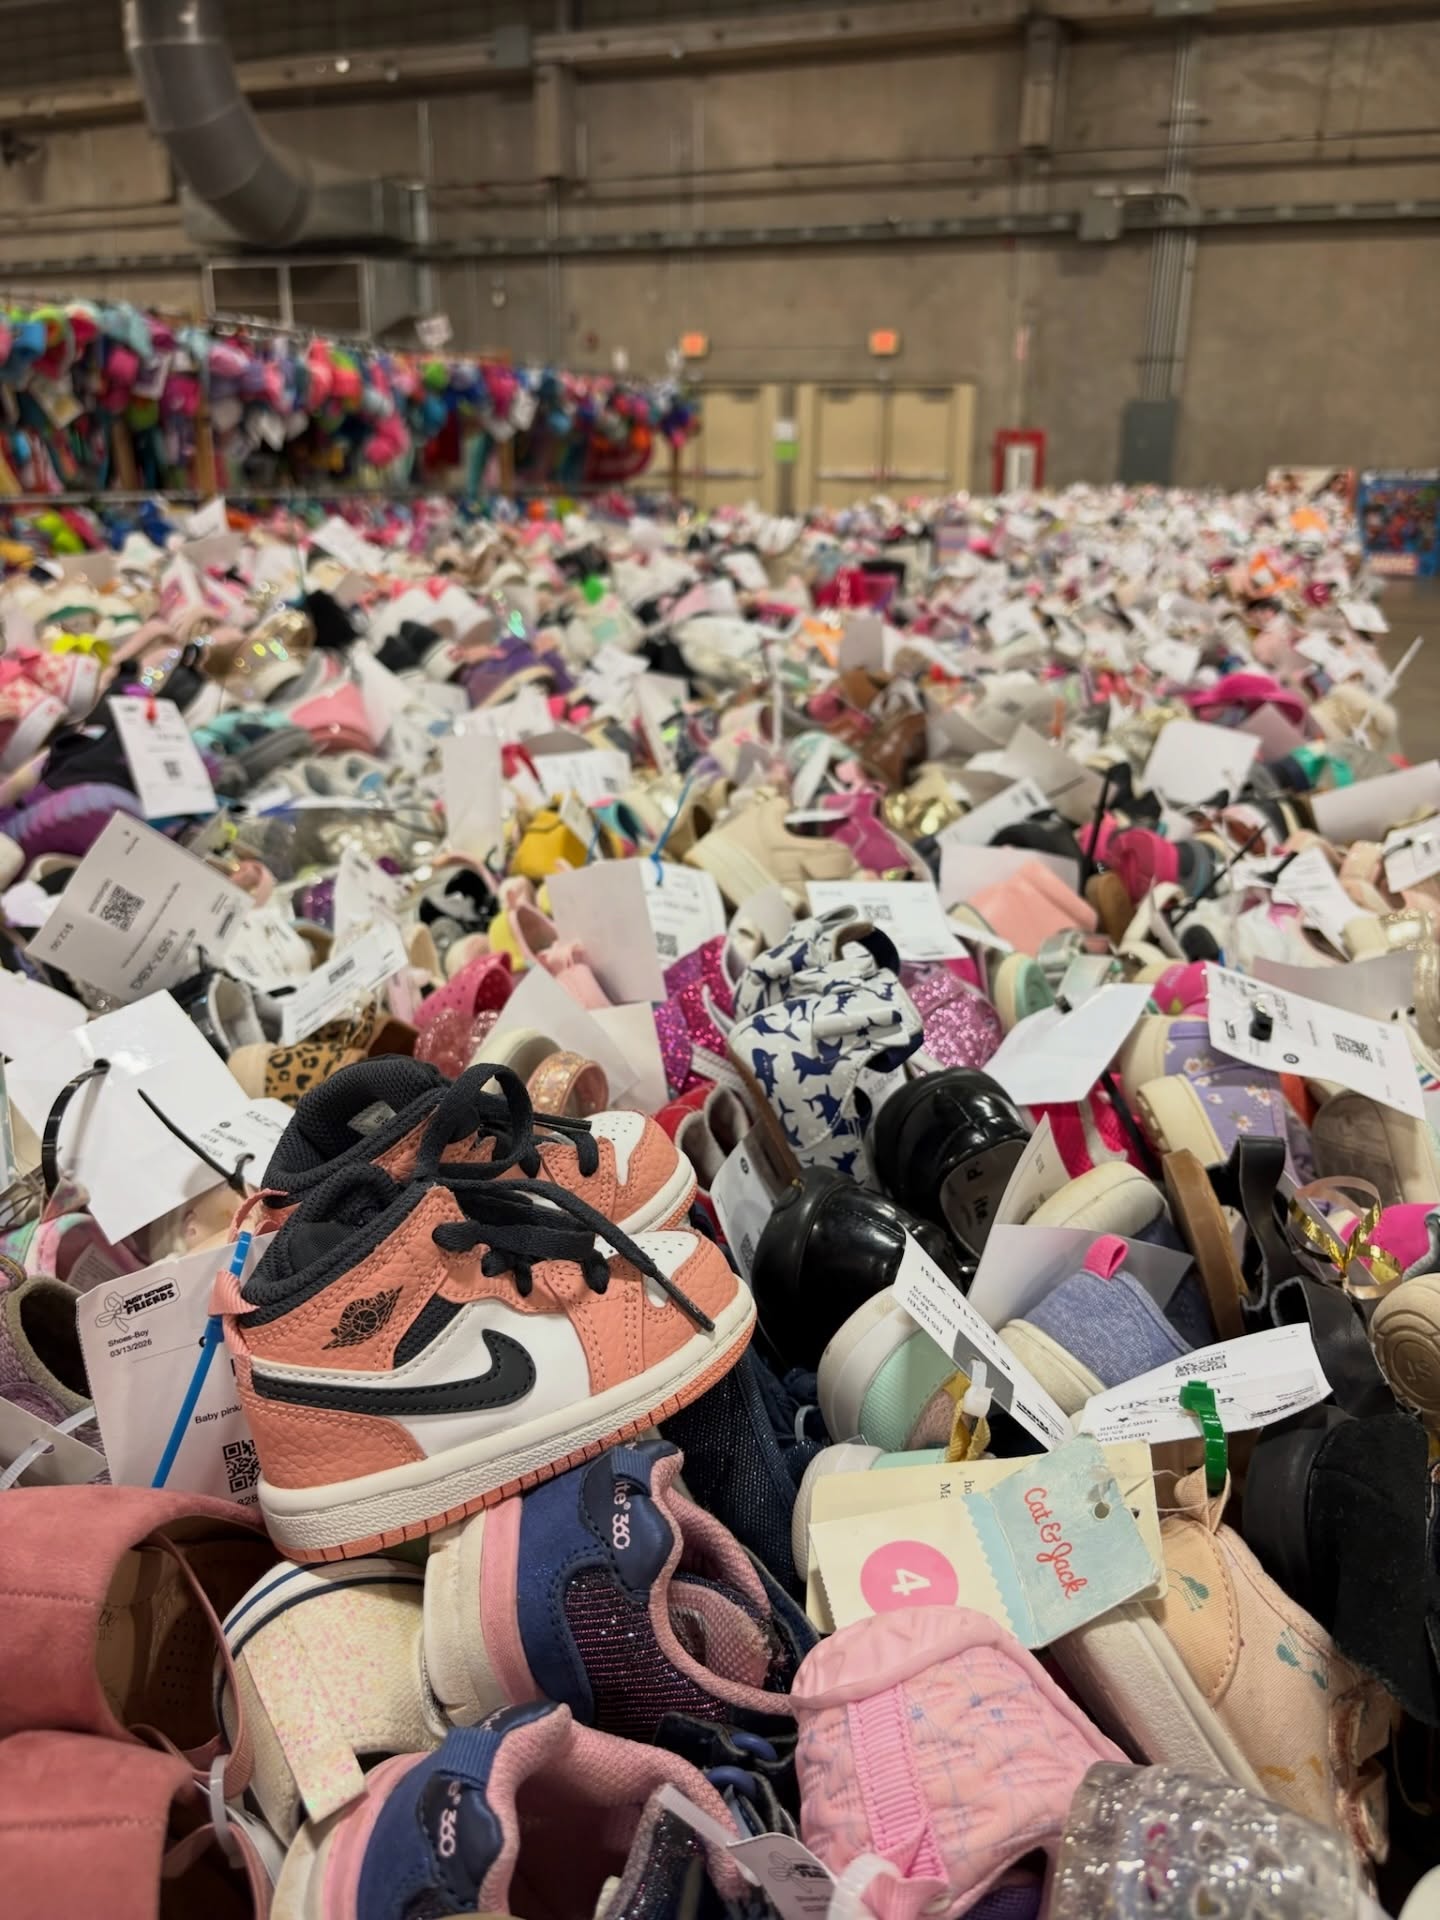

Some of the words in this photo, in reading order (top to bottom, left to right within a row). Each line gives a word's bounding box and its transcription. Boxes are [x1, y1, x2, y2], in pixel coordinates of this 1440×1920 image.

[126, 1290, 175, 1315] FRIENDS
[108, 1329, 149, 1348] Shoes-Boy
[195, 1411, 219, 1424] Baby
[1024, 1487, 1053, 1525] Cat
[612, 1513, 631, 1550] 360
[1039, 1522, 1062, 1543] &
[891, 1568, 932, 1596] 4
[1036, 1542, 1088, 1600] Jack
[438, 1808, 457, 1857] 360
